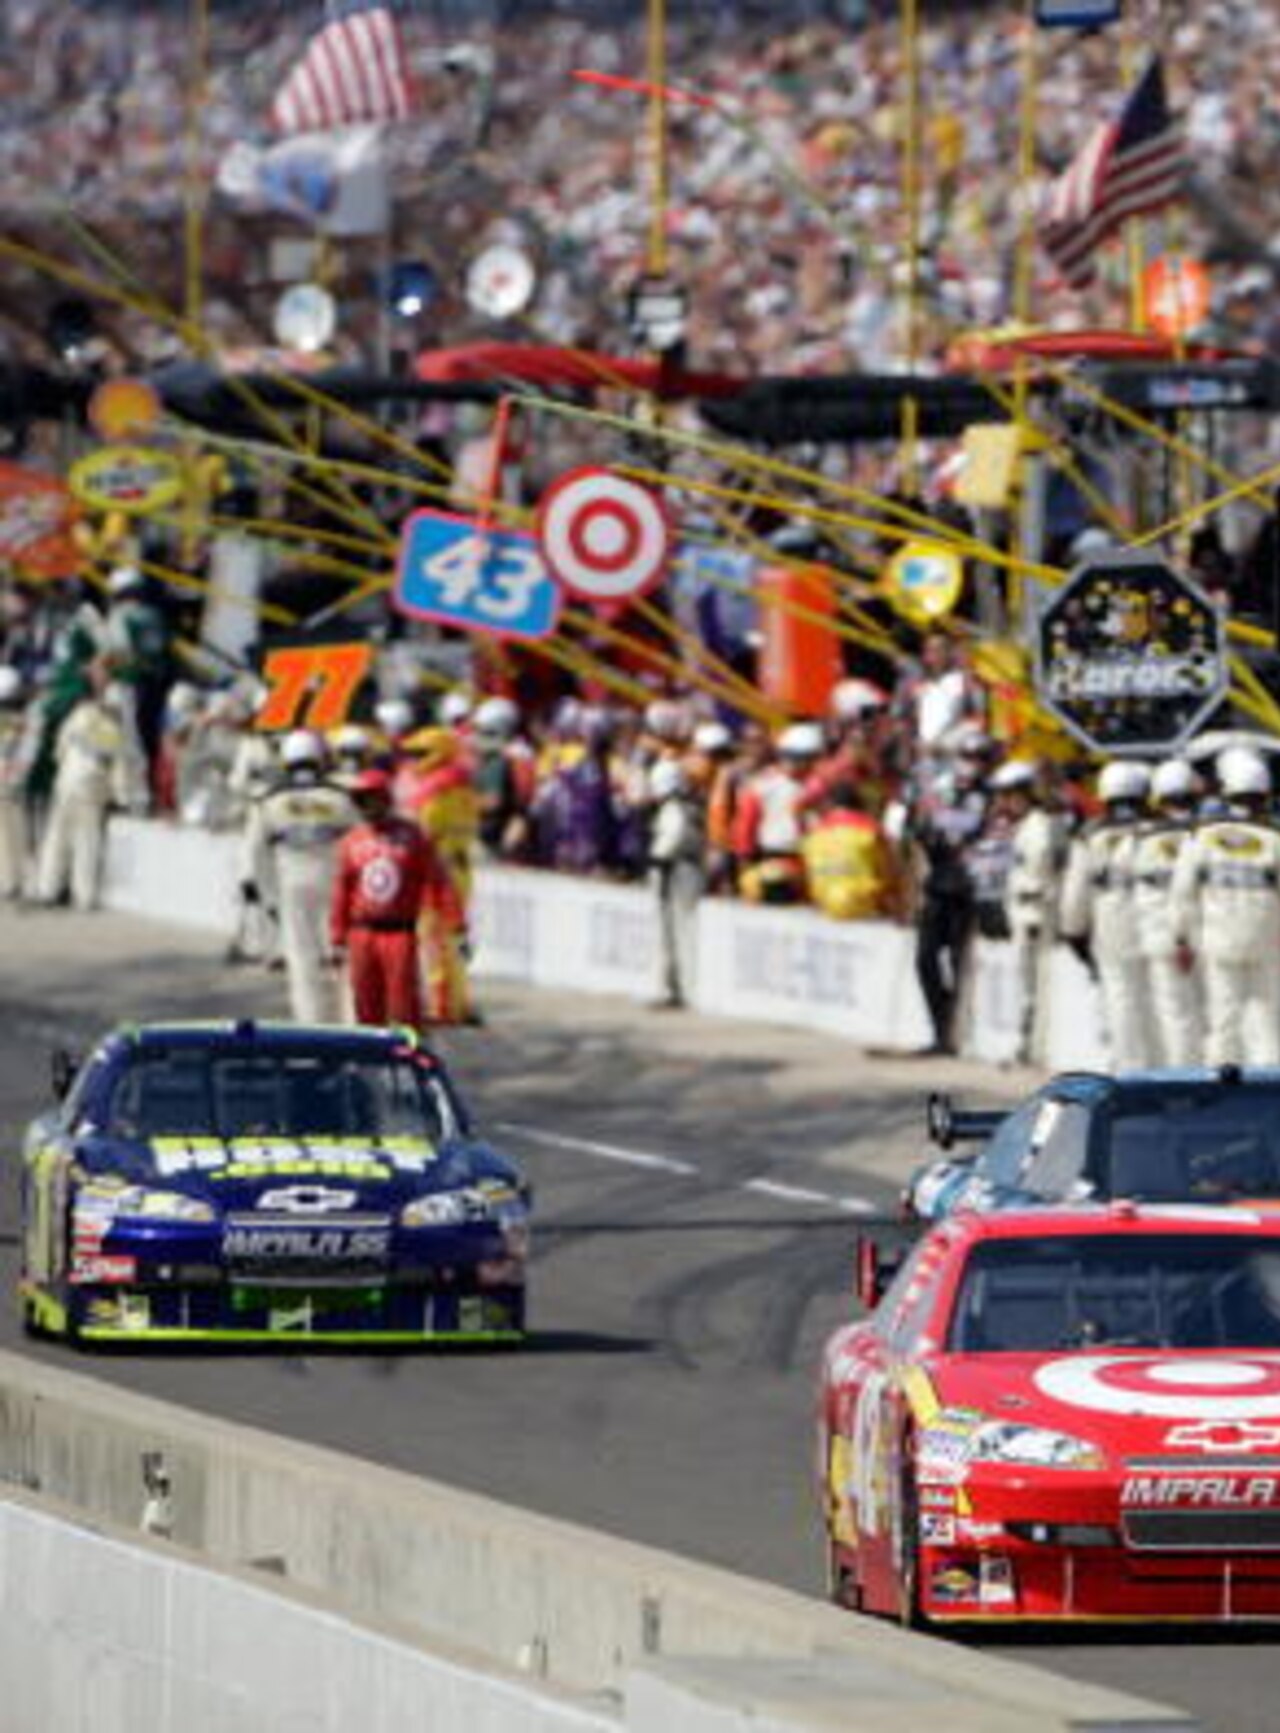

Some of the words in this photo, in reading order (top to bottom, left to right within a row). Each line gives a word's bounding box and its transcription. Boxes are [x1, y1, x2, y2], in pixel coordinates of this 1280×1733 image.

[423, 534, 547, 619] 43
[255, 643, 374, 728] 77
[1120, 1477, 1276, 1506] IMPALA
